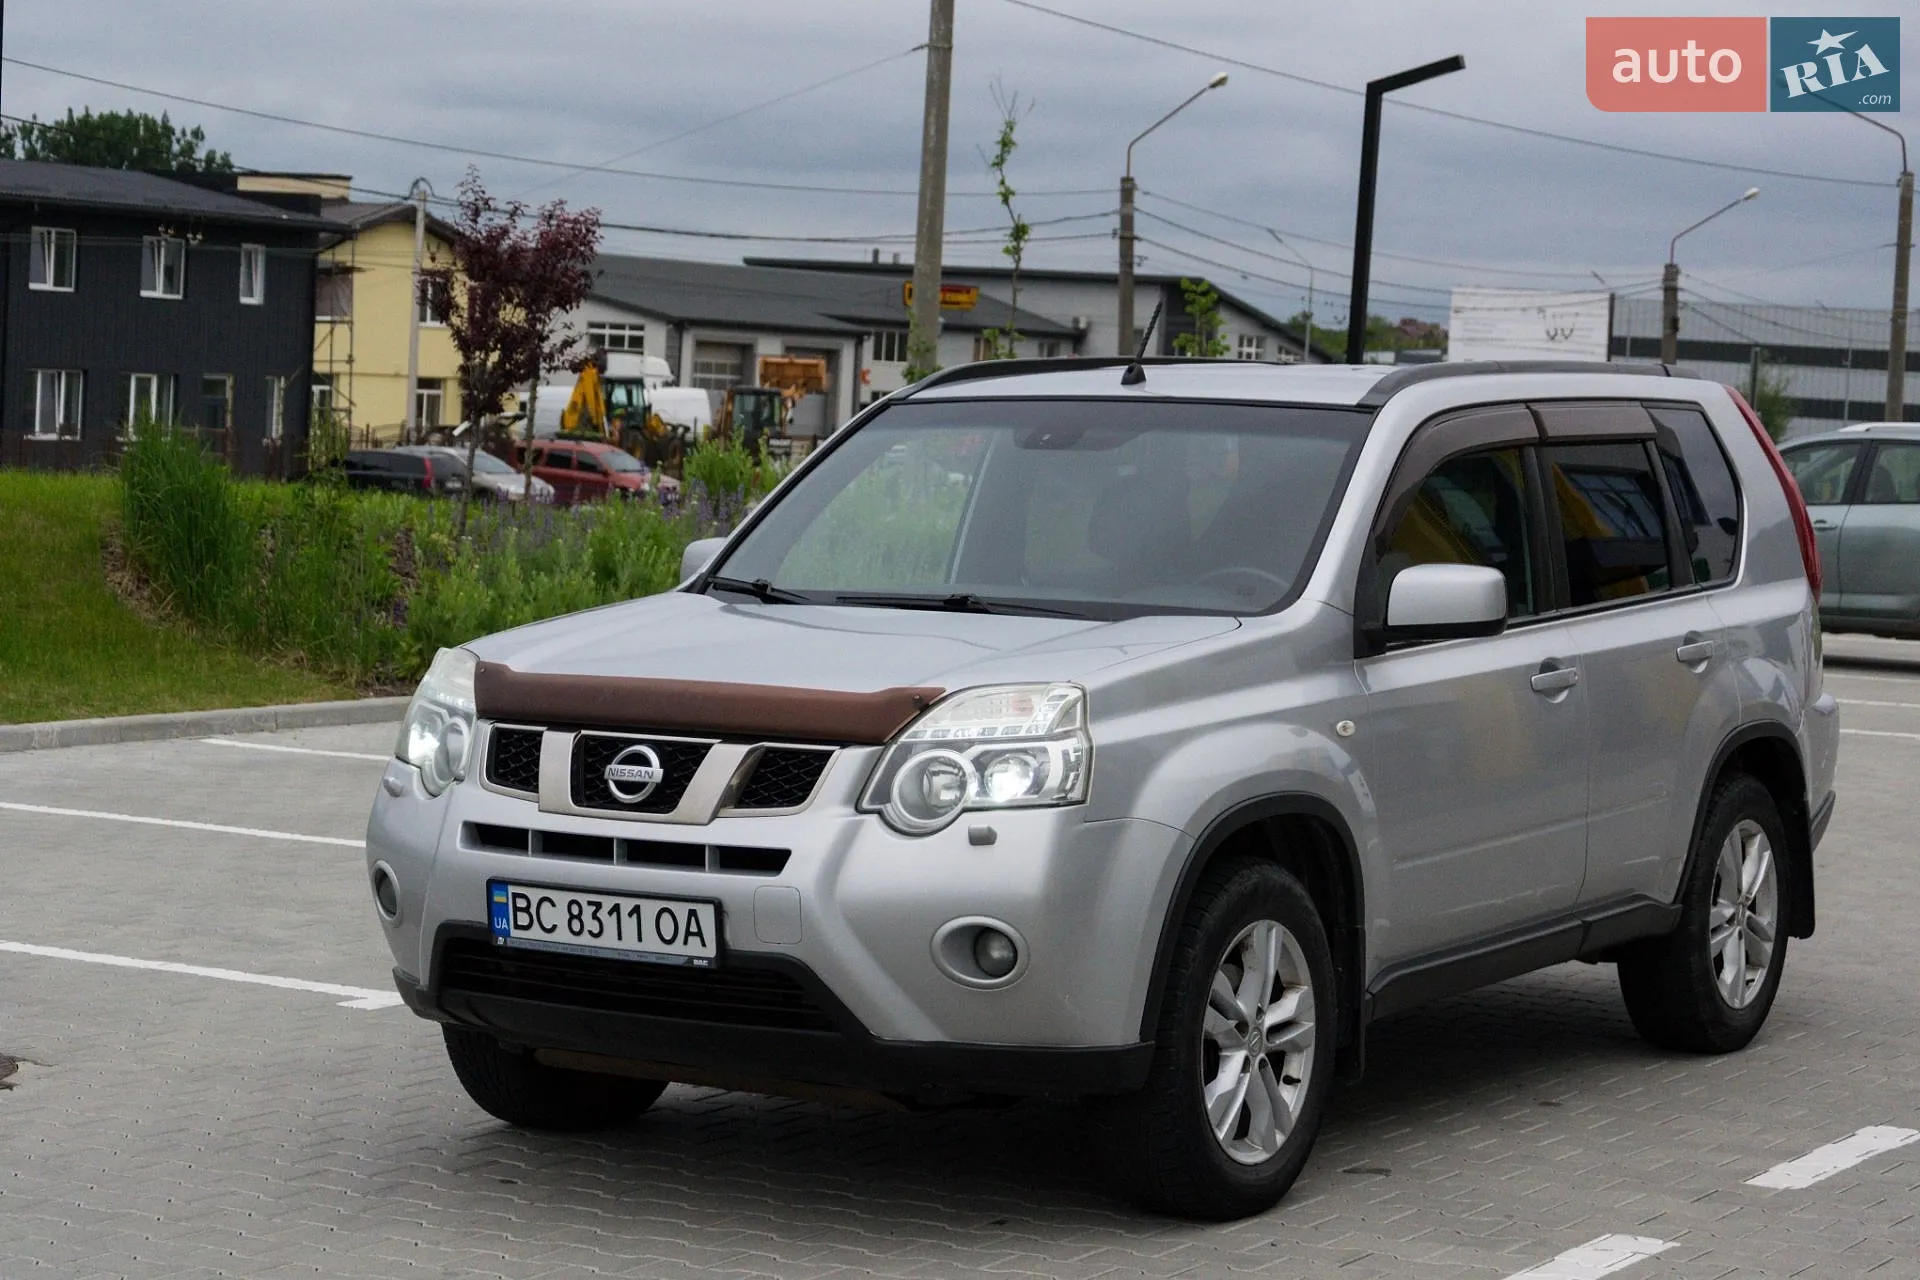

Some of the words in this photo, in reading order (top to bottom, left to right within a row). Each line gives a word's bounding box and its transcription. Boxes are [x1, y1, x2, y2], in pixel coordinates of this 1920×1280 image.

[607, 767, 654, 779] NISSAN
[494, 917, 509, 930] UA
[511, 892, 558, 934] BC
[567, 899, 643, 943] 8311
[655, 907, 707, 948] OA
